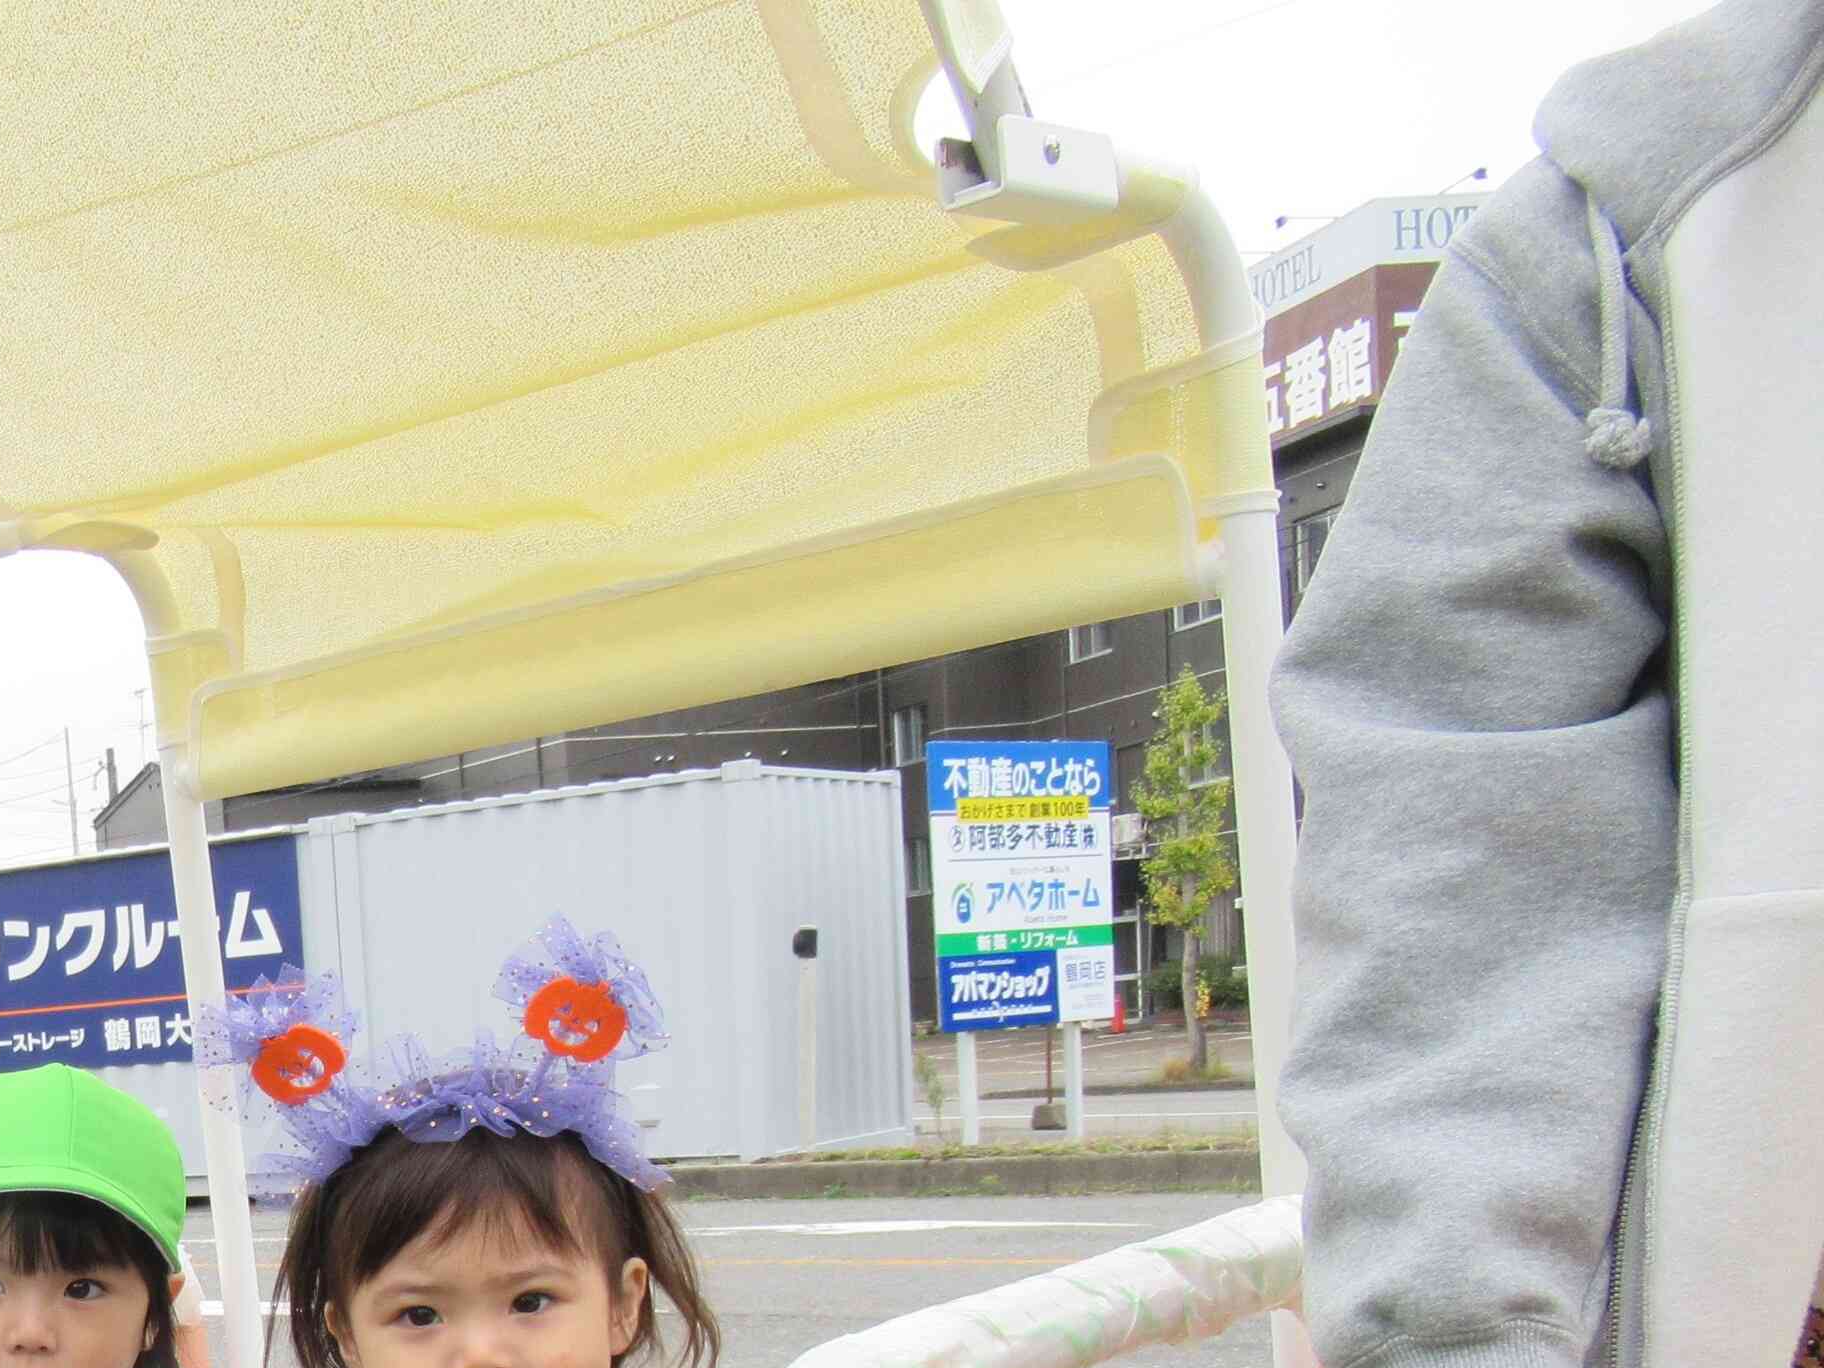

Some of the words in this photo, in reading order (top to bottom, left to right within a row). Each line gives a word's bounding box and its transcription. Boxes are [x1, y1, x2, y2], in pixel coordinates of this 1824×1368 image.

[943, 757, 1101, 800] 不動産のことなら
[986, 878, 1101, 914] アベタホーム
[950, 965, 1051, 1004] アパマンショップ
